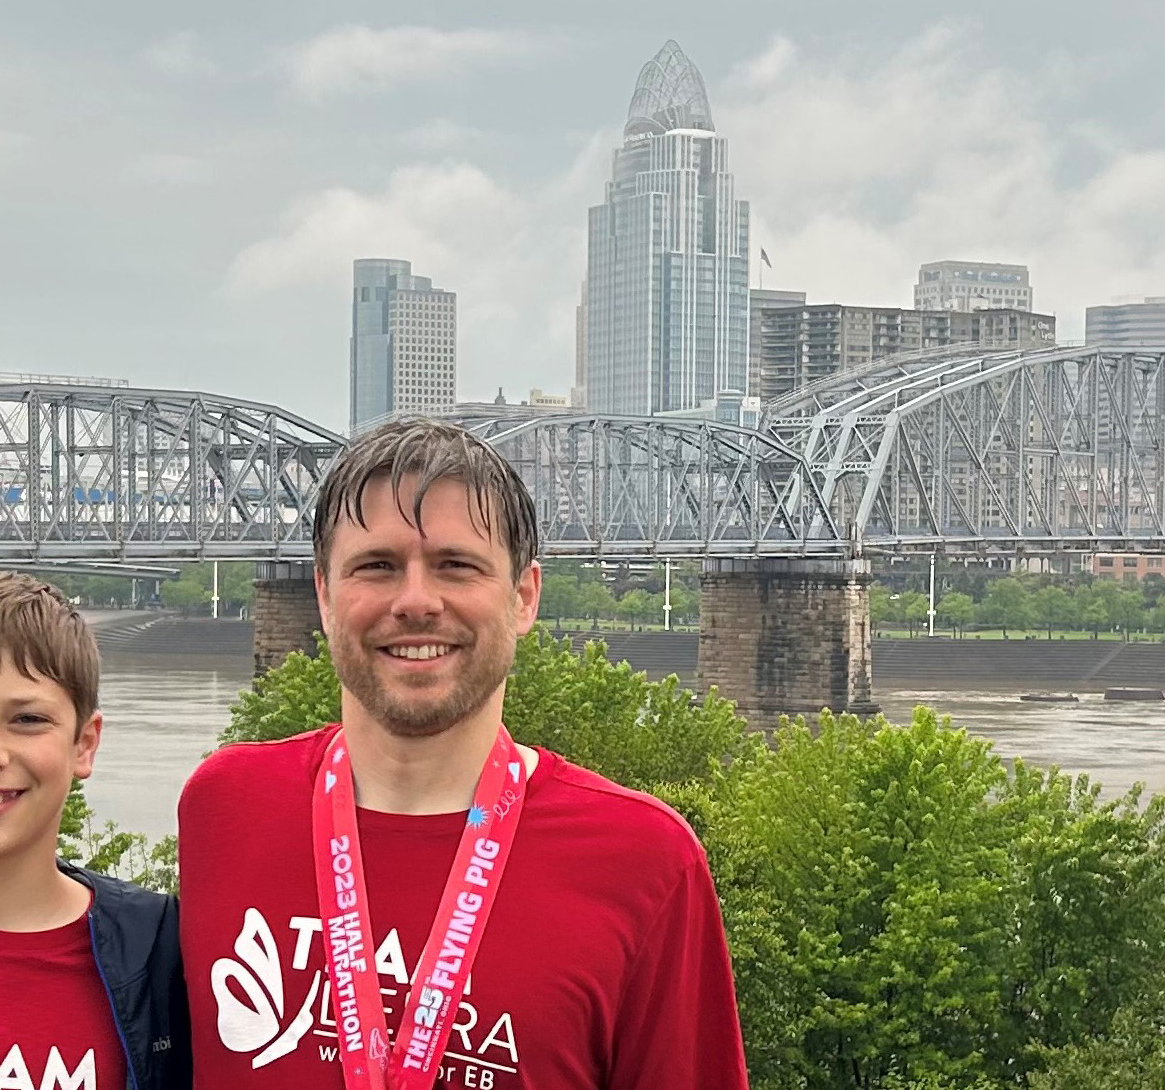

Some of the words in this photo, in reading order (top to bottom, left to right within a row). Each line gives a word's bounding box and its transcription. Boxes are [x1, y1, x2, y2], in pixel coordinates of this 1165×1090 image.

[330, 835, 357, 910] 2023
[343, 911, 367, 973] HALF
[403, 1026, 433, 1069] THE
[430, 891, 483, 989] FLYING
[464, 837, 500, 887] PIG
[328, 915, 364, 1052] MARATHON
[465, 1065, 494, 1090] EB
